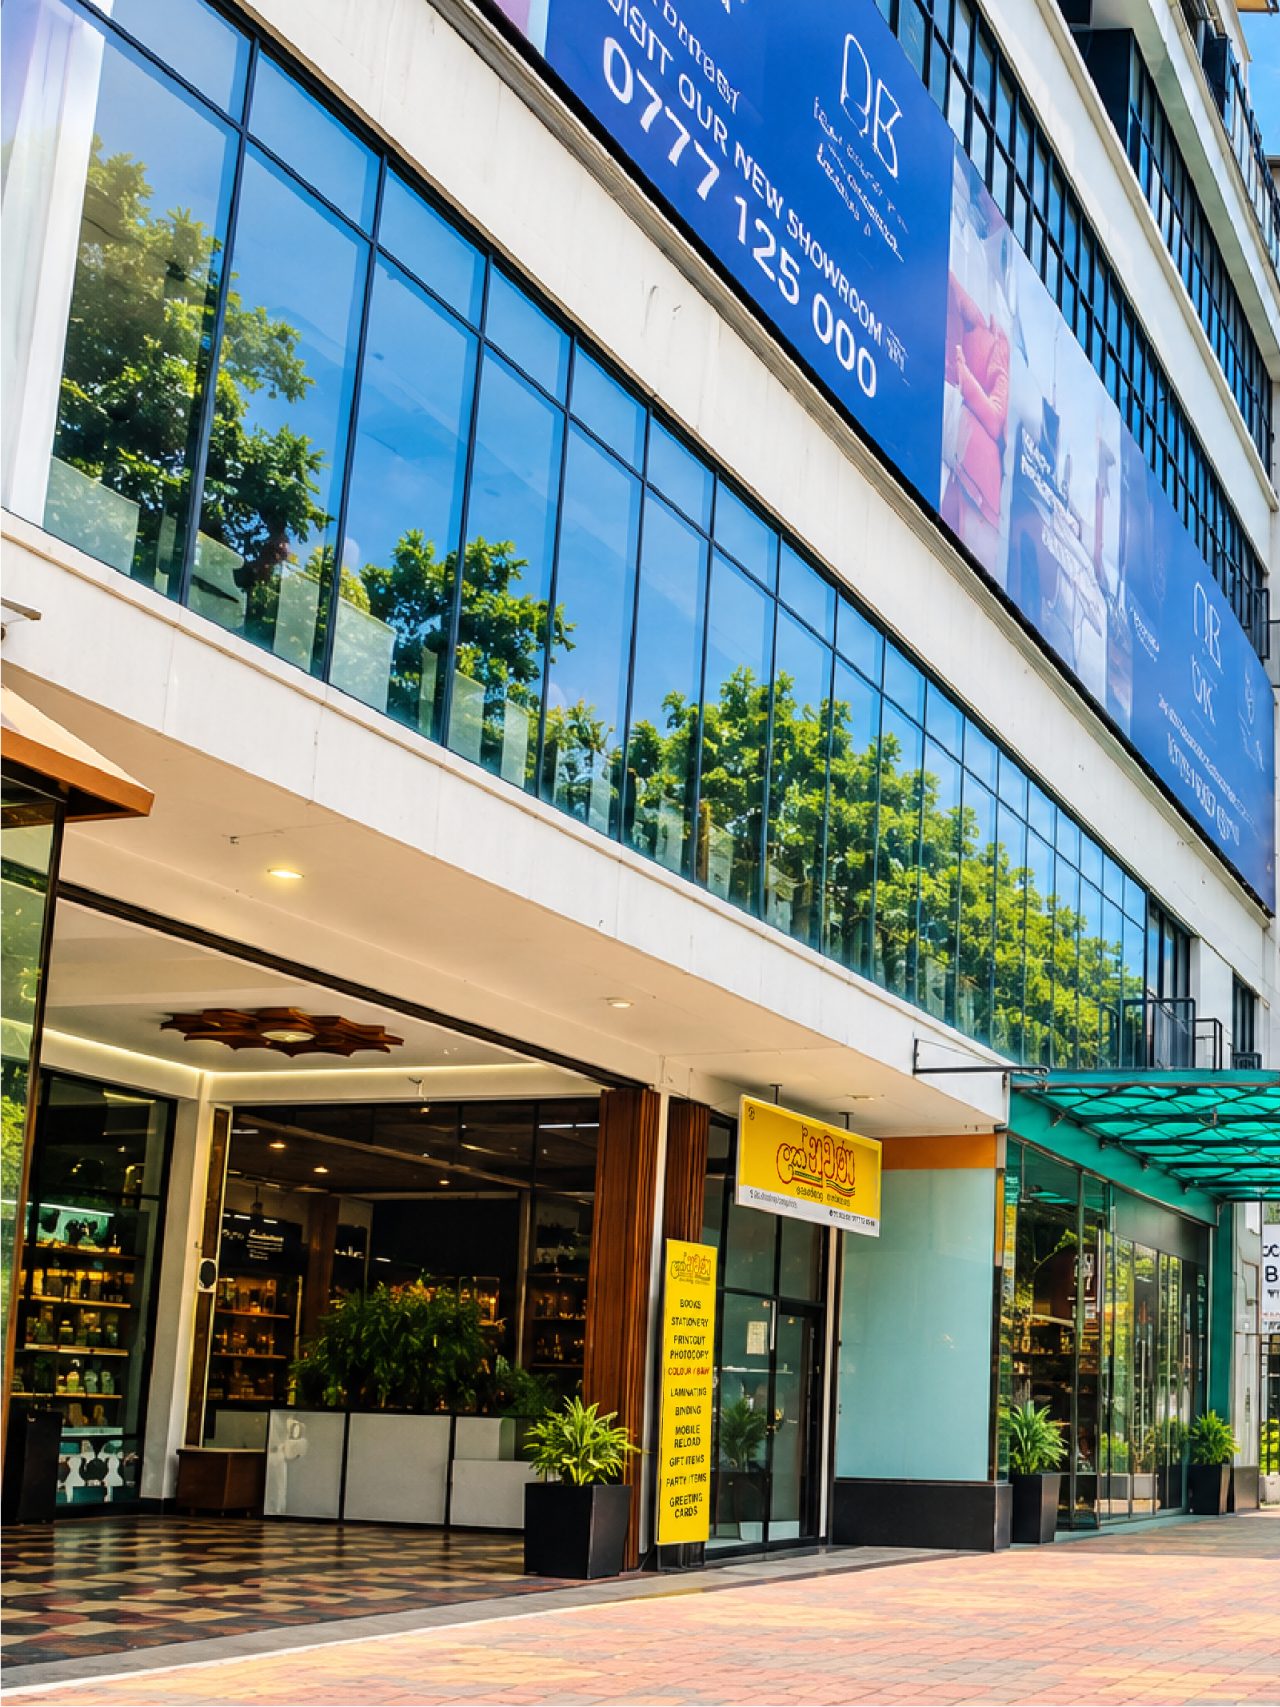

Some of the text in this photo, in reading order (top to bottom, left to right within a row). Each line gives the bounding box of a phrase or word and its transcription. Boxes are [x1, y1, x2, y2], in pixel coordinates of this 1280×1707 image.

[679, 73, 728, 156] OUR
[734, 142, 784, 219] NEW
[787, 208, 882, 346] SHOWROOM
[603, 36, 720, 201] 0777
[736, 196, 800, 305] 125
[812, 293, 877, 398] 000
[680, 1299, 701, 1310] BOOKS
[671, 1316, 709, 1328] STATIONERY
[673, 1334, 706, 1346] PRINTOUT
[669, 1349, 709, 1360] PHOTOCOPY
[667, 1367, 692, 1376] COLOUR
[670, 1387, 707, 1398] LAMINATING
[675, 1405, 702, 1416] BINDING
[675, 1424, 701, 1436] MOBILE
[674, 1436, 701, 1449] RELOAD
[669, 1454, 705, 1467] GIFT ITEMS
[666, 1472, 707, 1487] PARTY ITEMS
[669, 1492, 703, 1508] GREETING
[674, 1505, 698, 1519] CARDS
